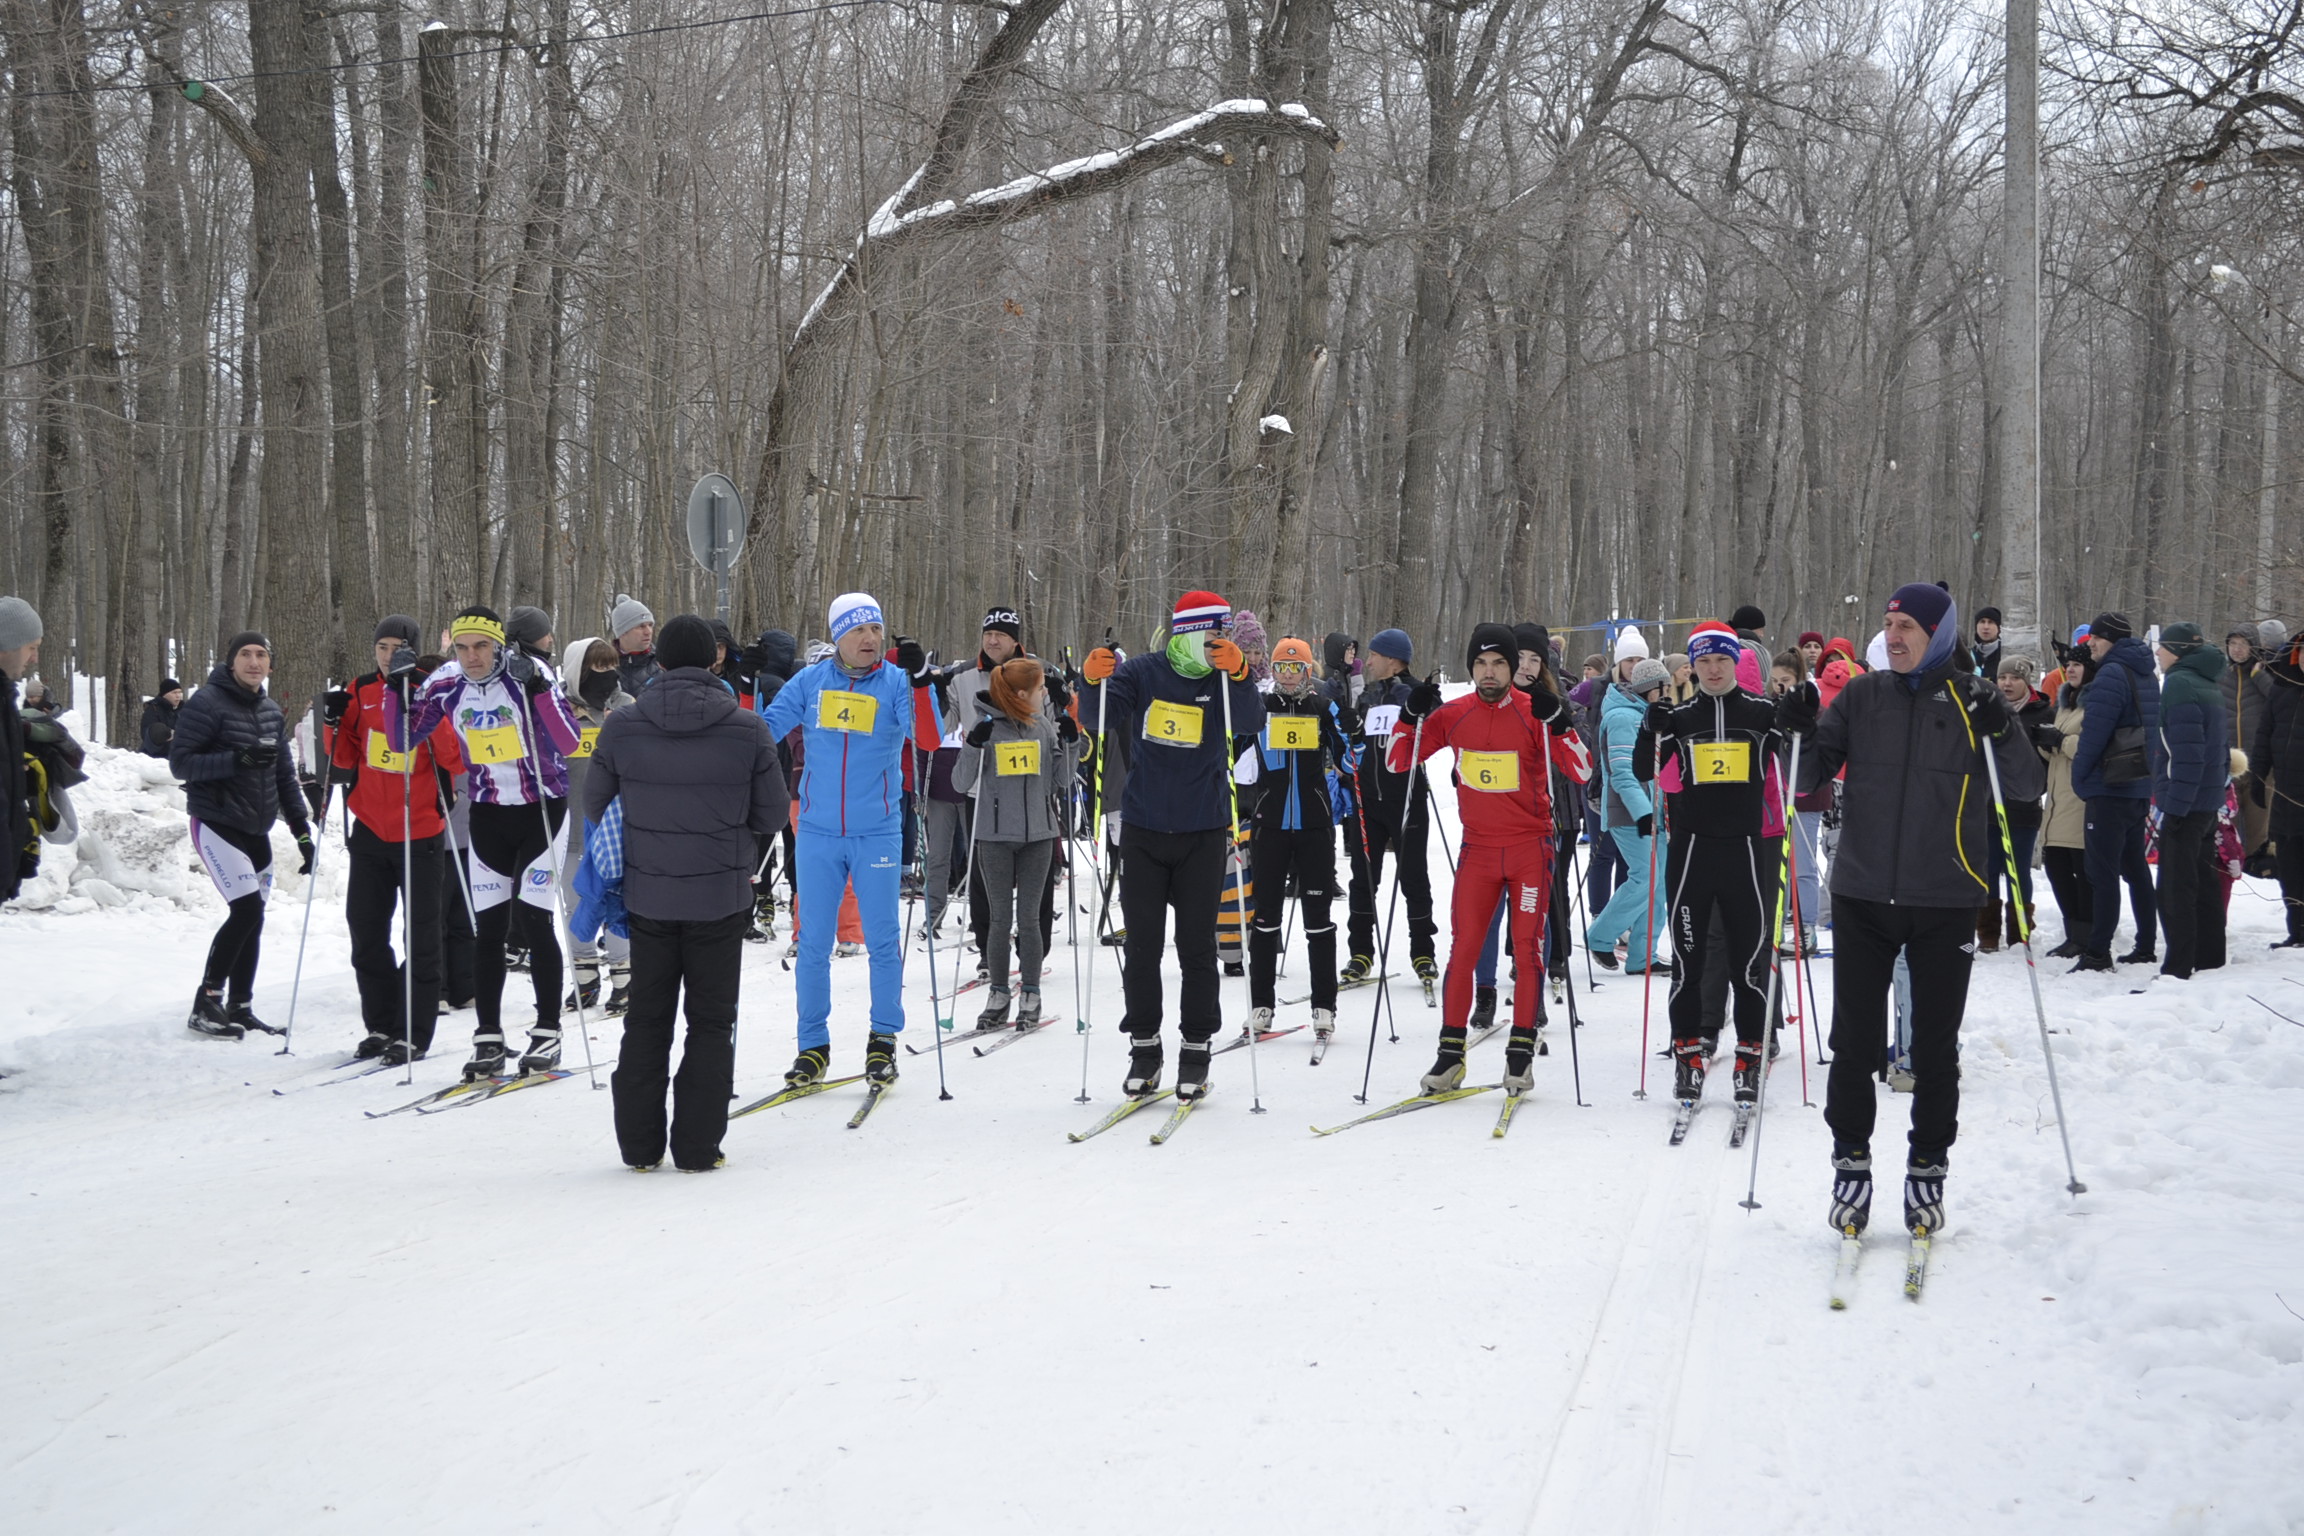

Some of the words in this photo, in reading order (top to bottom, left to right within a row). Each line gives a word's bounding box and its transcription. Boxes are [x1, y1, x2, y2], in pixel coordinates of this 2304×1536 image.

[837, 707, 850, 723] 4
[1373, 715, 1389, 731] 21
[1163, 719, 1176, 736] 3
[1286, 730, 1298, 745] 8
[485, 744, 496, 758] 1
[582, 741, 593, 754] 9
[380, 749, 392, 764] 5
[1008, 754, 1029, 769] 11
[1711, 759, 1725, 776] 2
[1479, 768, 1492, 785] 6
[471, 882, 502, 892] PENZA
[1519, 885, 1539, 914] SWIX
[1680, 905, 1694, 943] CRAFT
[784, 1083, 824, 1101] FISCHER
